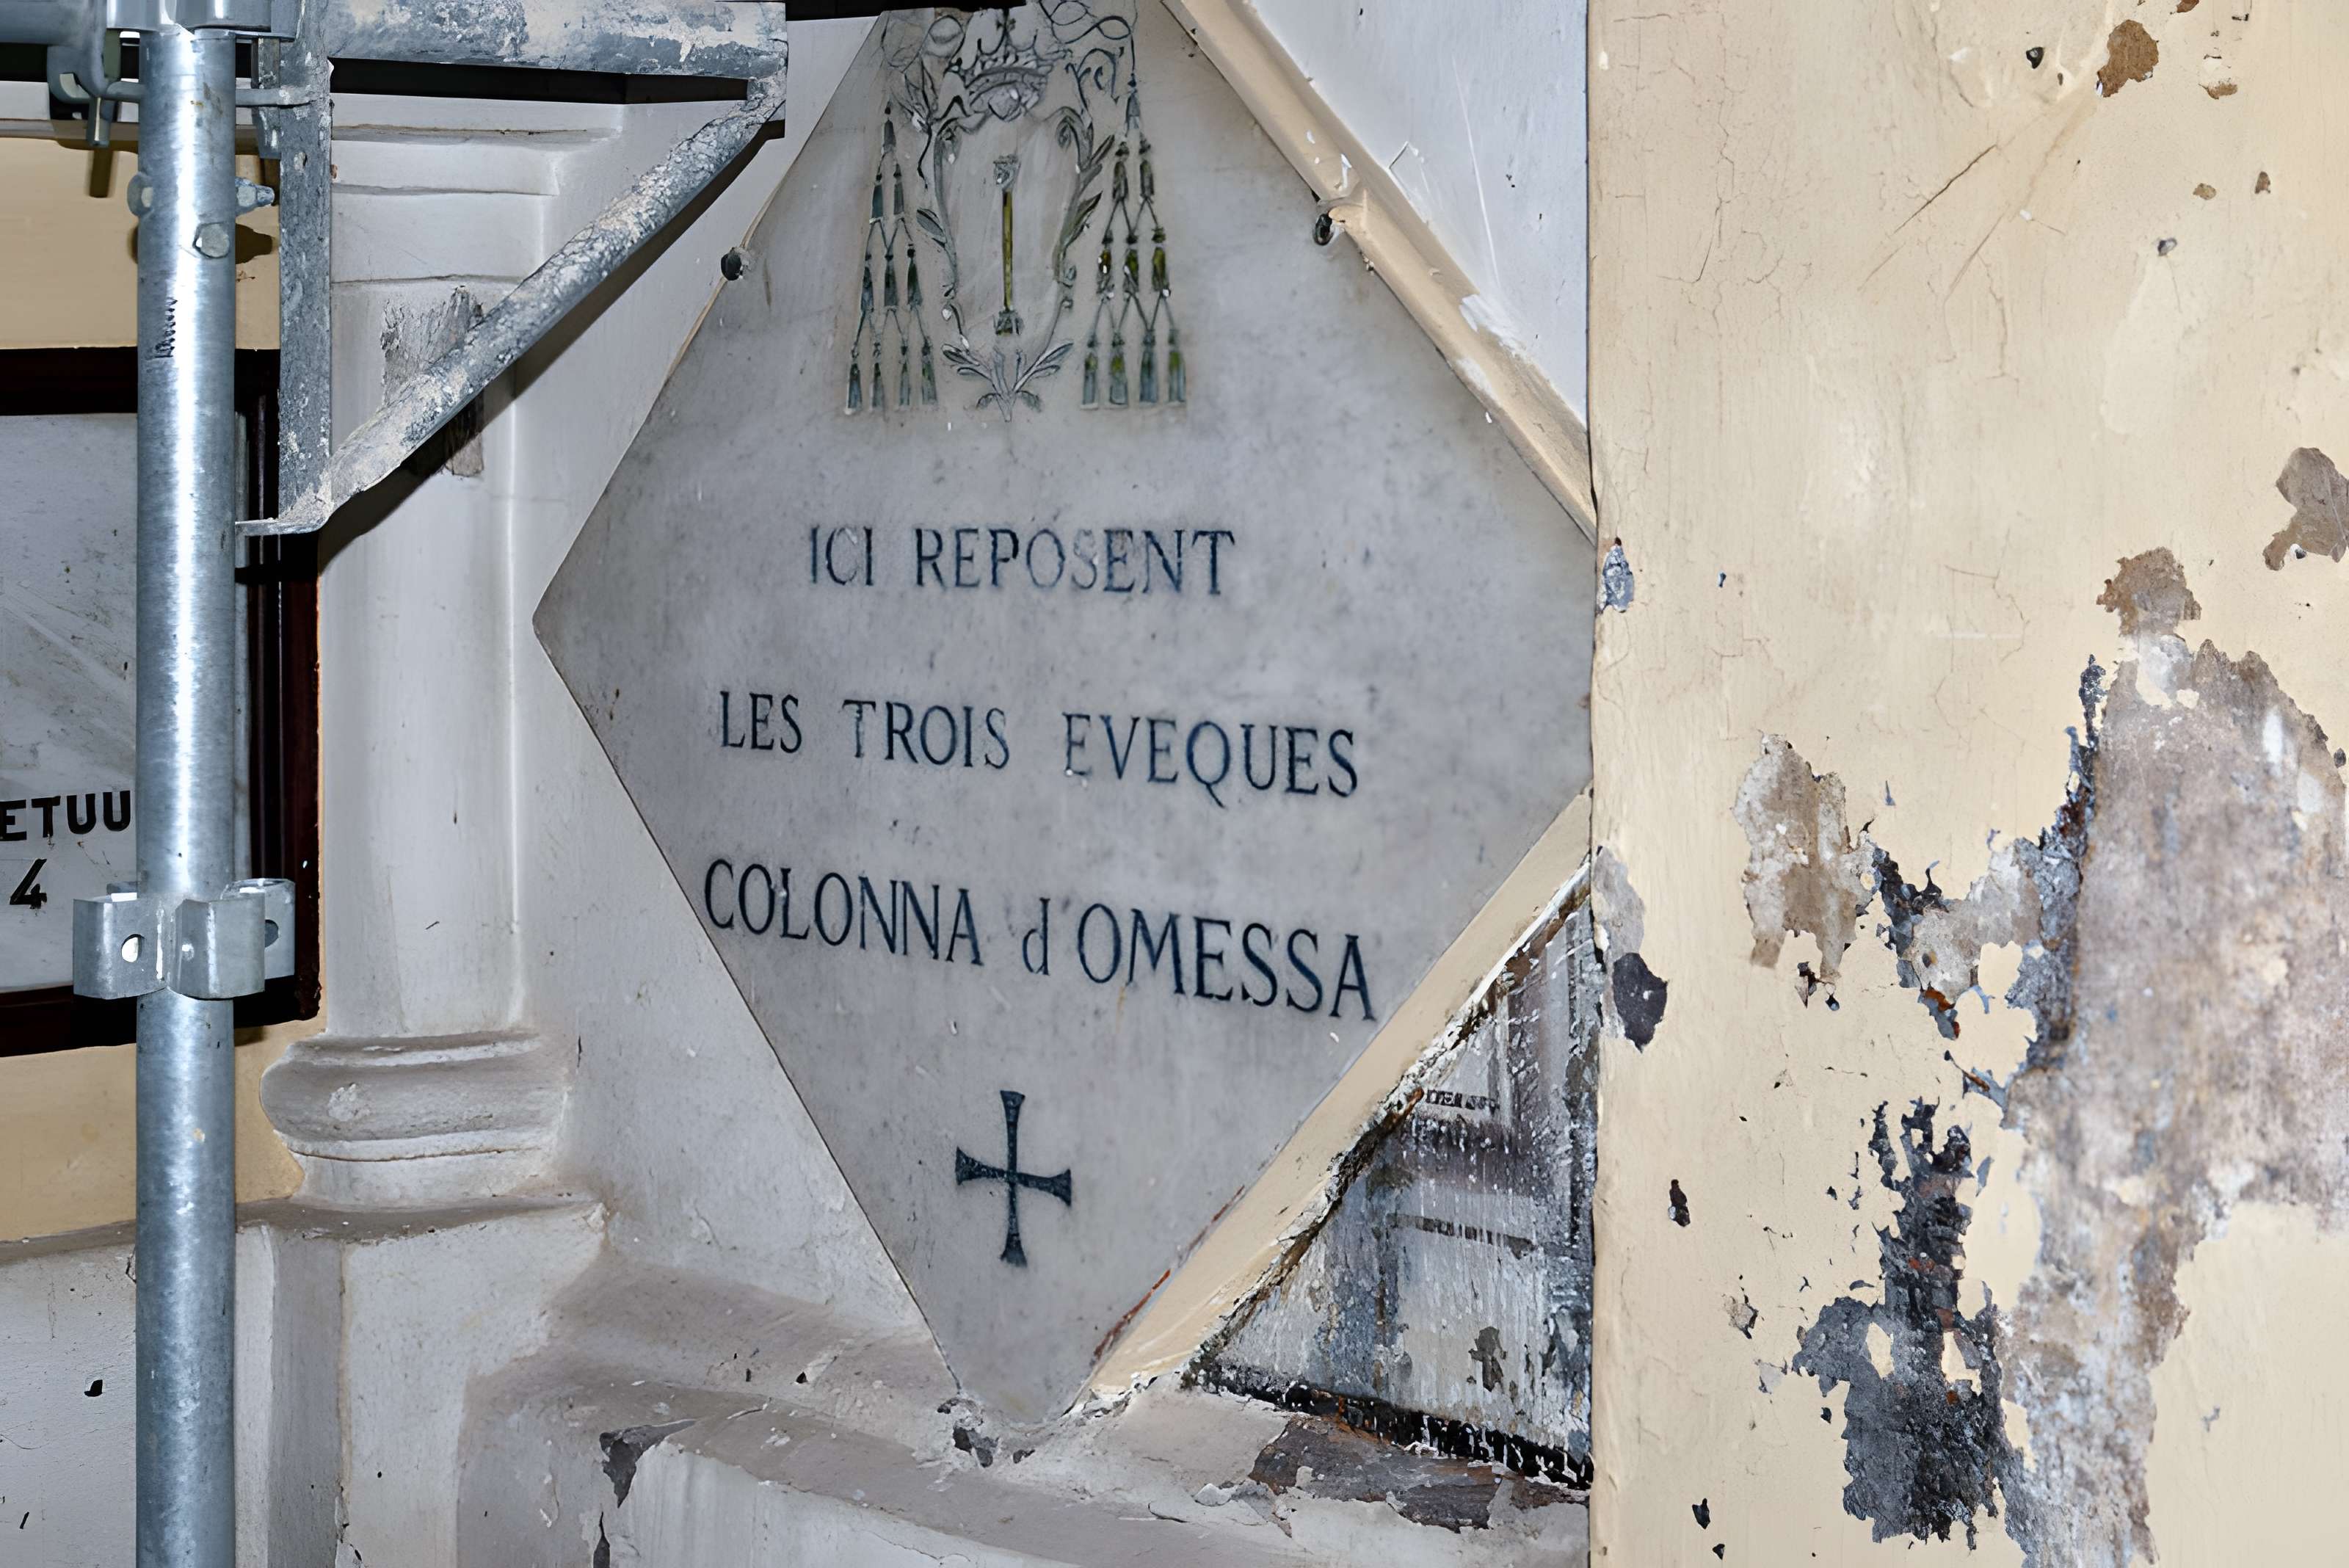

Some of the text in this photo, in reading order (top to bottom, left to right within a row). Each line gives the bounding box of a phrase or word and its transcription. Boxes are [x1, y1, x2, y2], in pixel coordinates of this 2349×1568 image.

[808, 524, 1236, 597] ICI REPOSENT
[719, 690, 1358, 809] LES TROIS EVEQUES
[703, 857, 984, 967] COLONNA
